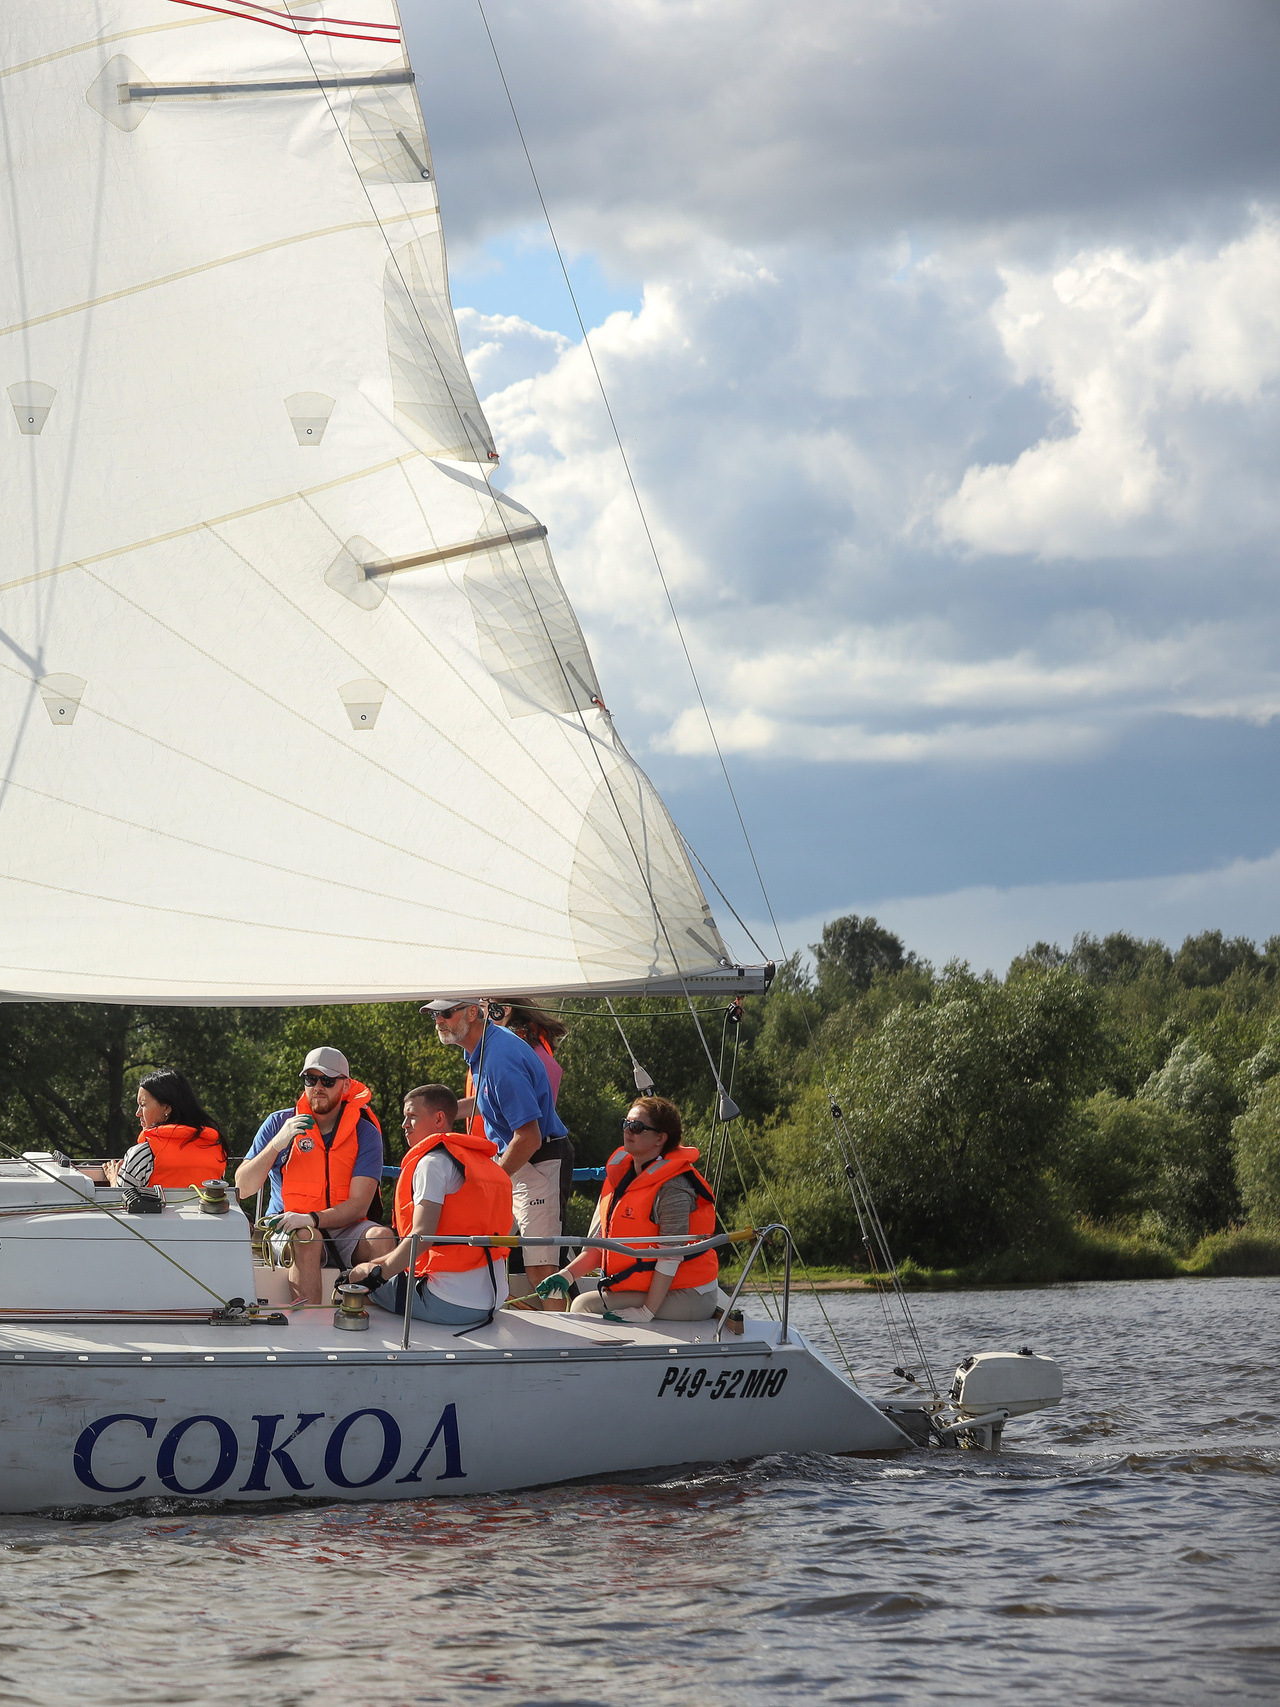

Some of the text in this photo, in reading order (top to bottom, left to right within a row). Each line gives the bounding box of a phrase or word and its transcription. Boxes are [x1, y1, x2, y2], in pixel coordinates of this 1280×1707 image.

[529, 1198, 545, 1206] Gill
[657, 1366, 788, 1400] Р49-52МЮ
[73, 1402, 468, 1495] СОКОЛ
